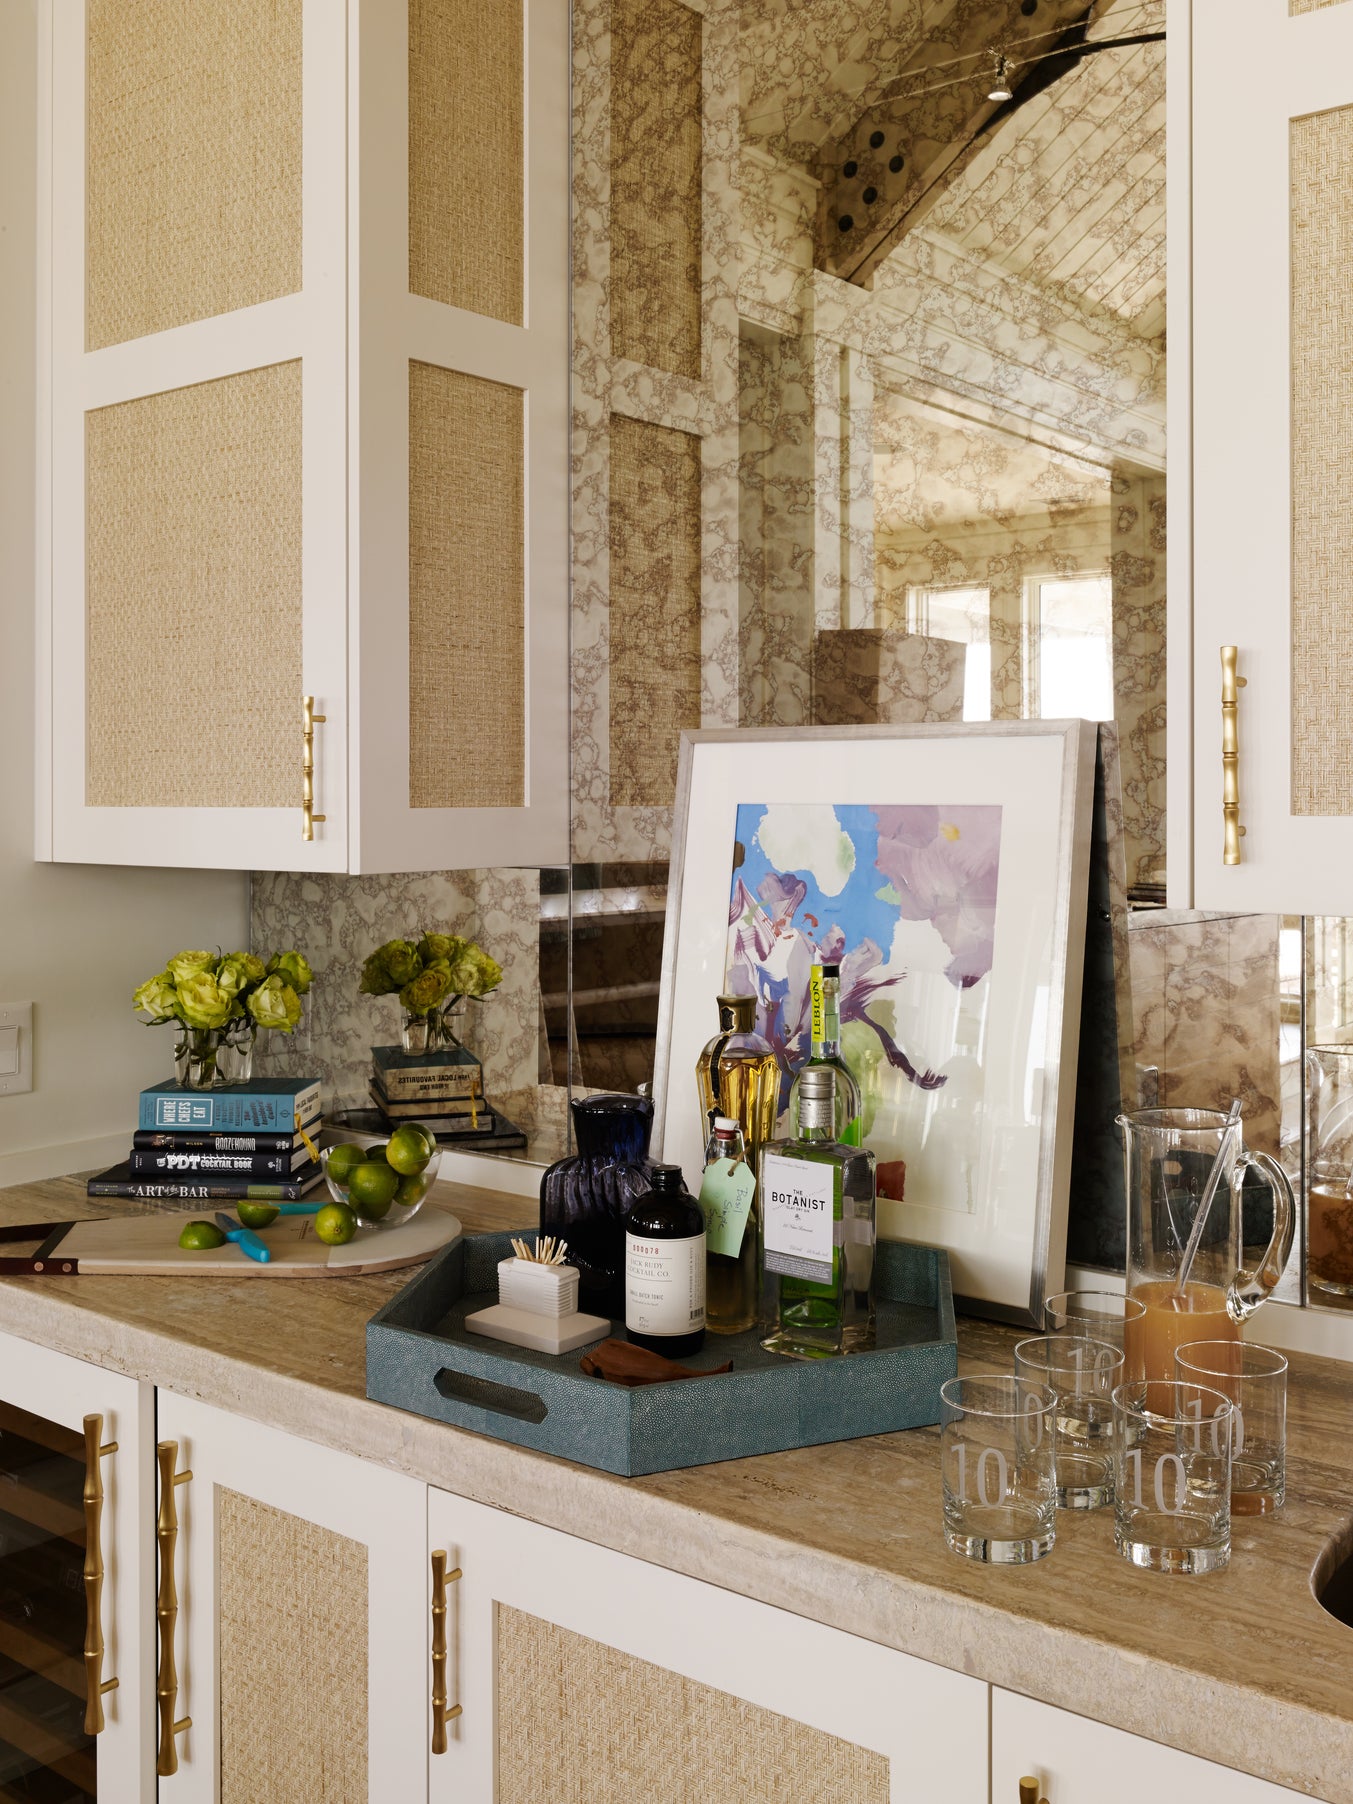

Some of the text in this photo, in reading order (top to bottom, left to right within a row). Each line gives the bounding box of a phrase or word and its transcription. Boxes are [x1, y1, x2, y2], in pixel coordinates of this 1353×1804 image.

[812, 981, 821, 1035] LEBLON
[163, 1101, 176, 1123] WHERE
[178, 1101, 191, 1122] CHEFS
[193, 1106, 206, 1118] EAT
[215, 1137, 256, 1151] BOOZEHOUND
[166, 1154, 200, 1169] PDT
[201, 1160, 252, 1168] COCKTAIL BOOK
[135, 1185, 164, 1197] ART
[179, 1186, 209, 1198] BAR
[772, 1191, 826, 1211] BOTANIST
[632, 1244, 659, 1255] 000078
[1187, 1399, 1244, 1461] 10
[951, 1444, 1008, 1510] 10
[1125, 1449, 1187, 1516] 10
